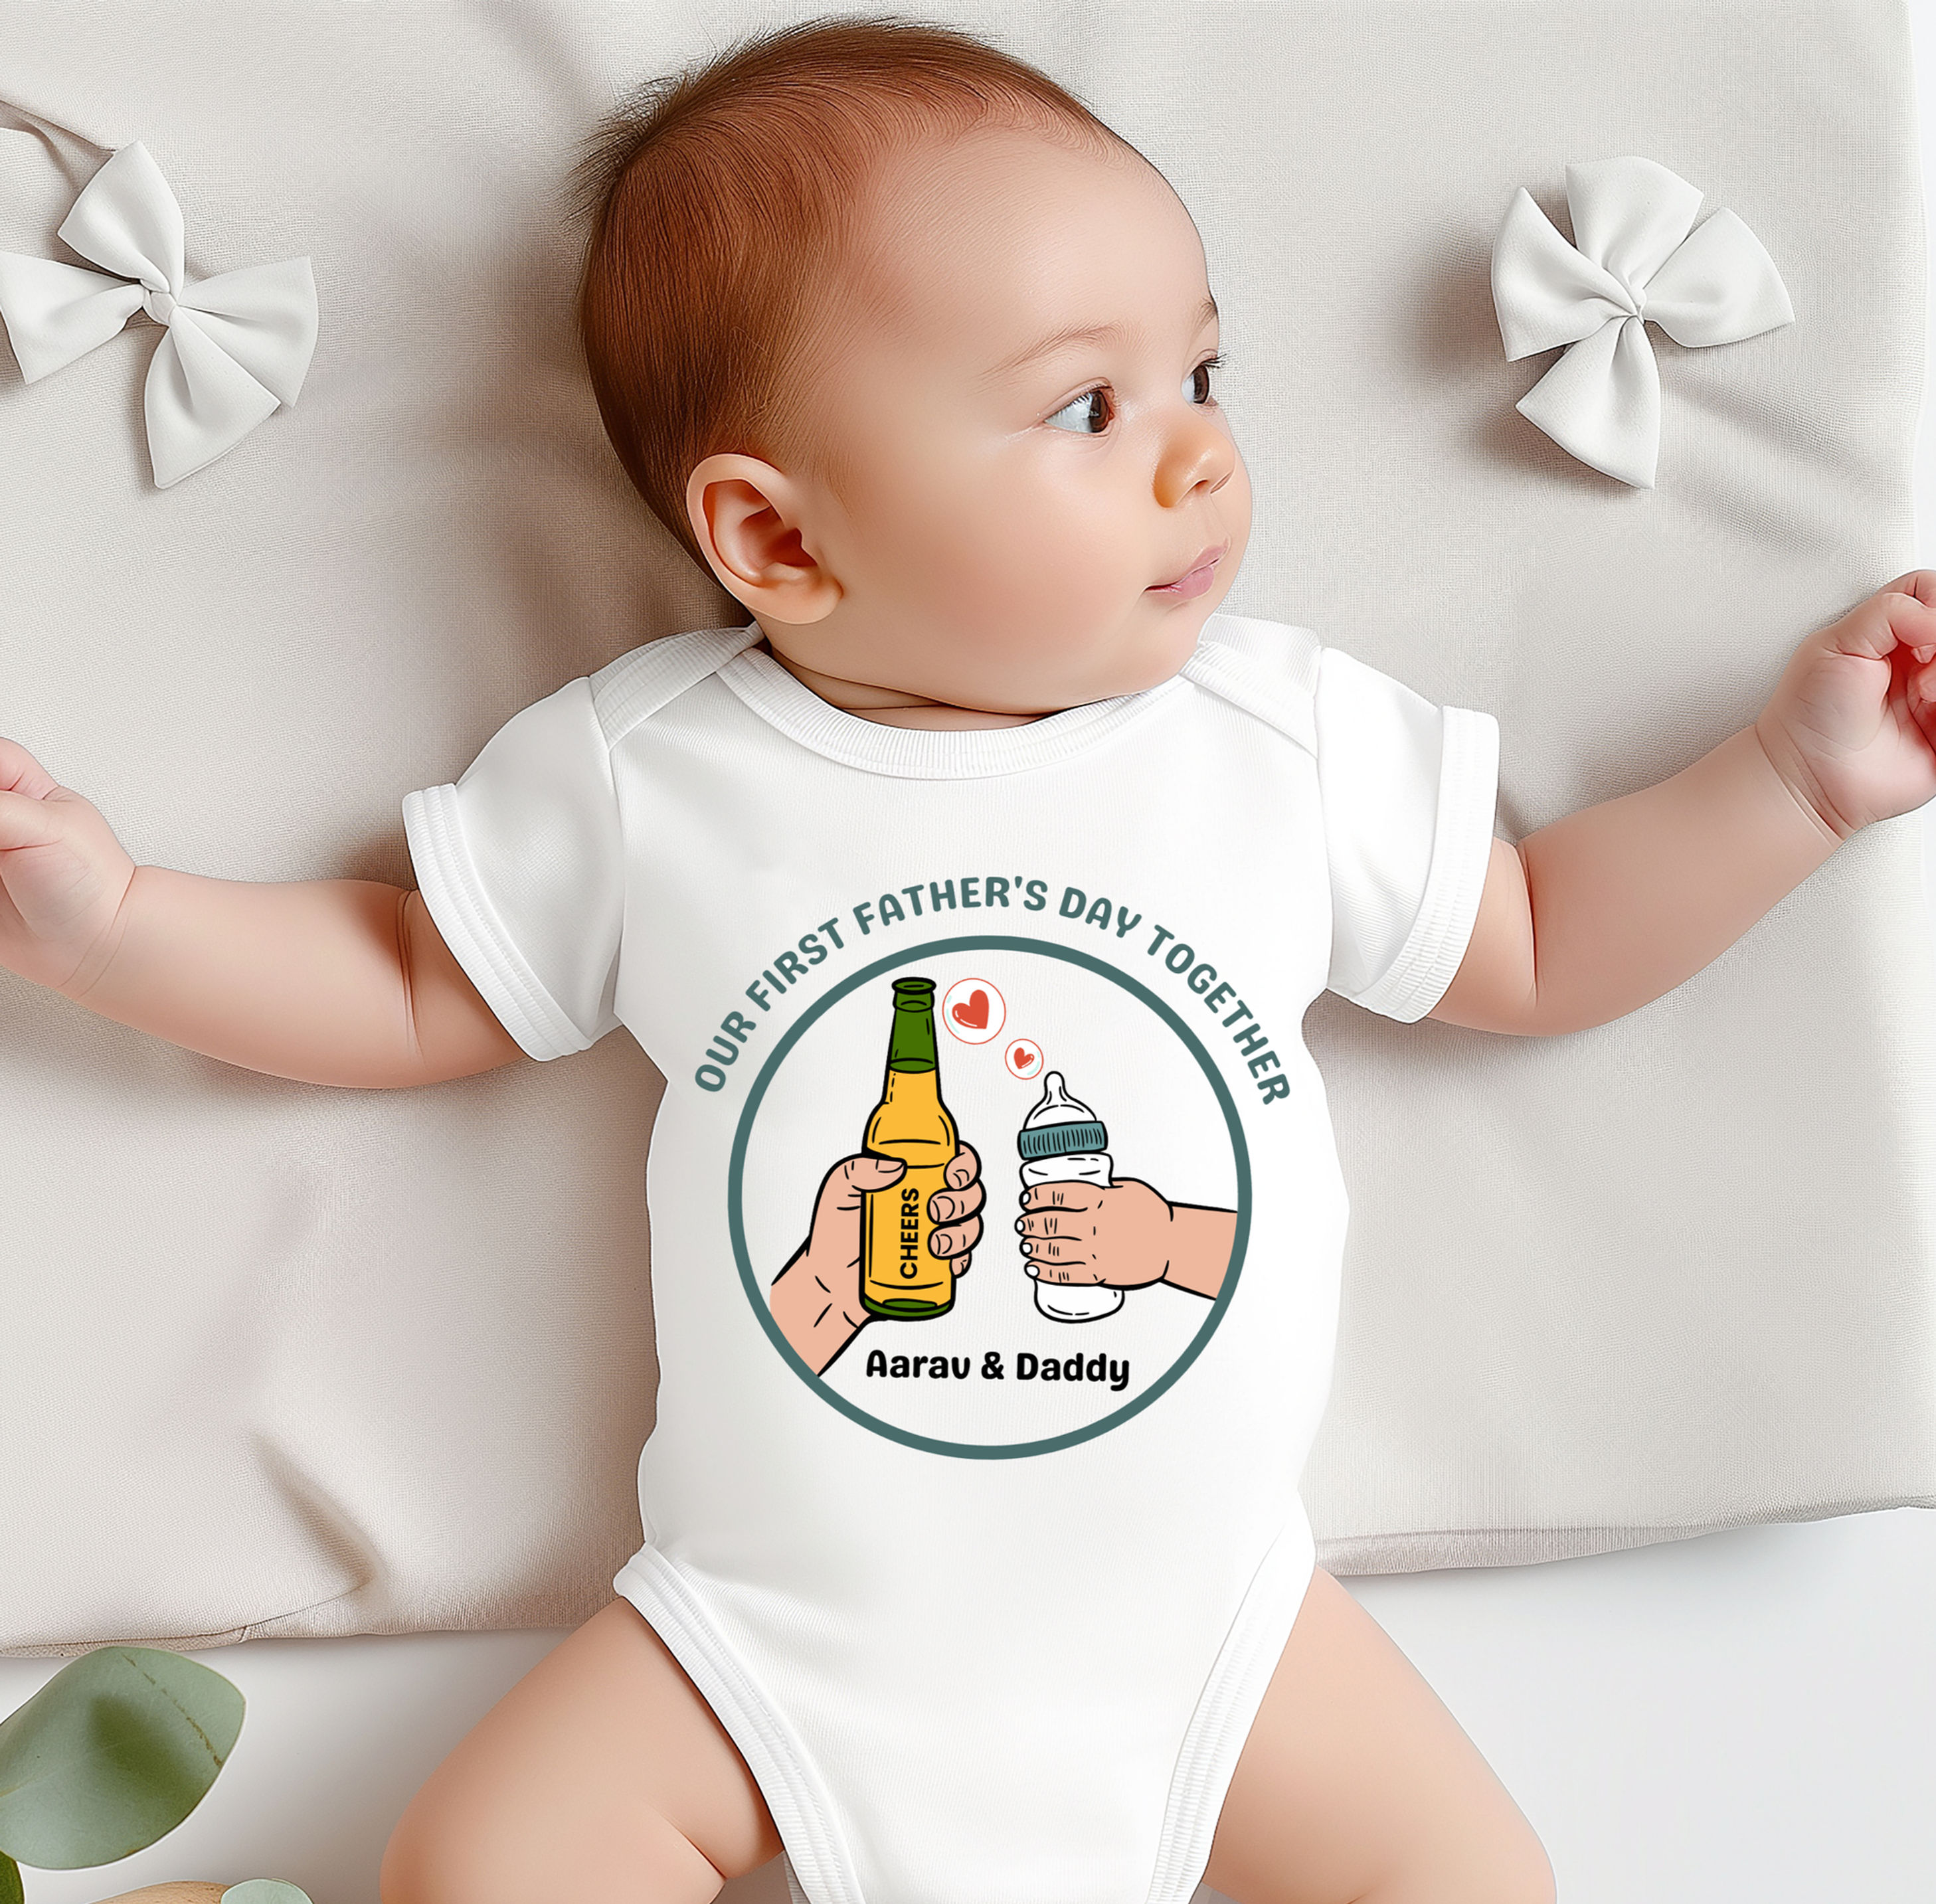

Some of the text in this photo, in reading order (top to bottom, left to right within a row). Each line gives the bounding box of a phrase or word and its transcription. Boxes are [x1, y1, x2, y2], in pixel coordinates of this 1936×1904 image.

[694, 875, 1290, 1105] OUR FIRST FATHER'S DAY TOGETHER
[900, 1187, 919, 1279] CHEERS
[865, 1349, 1130, 1392] Aarav & Daddy
